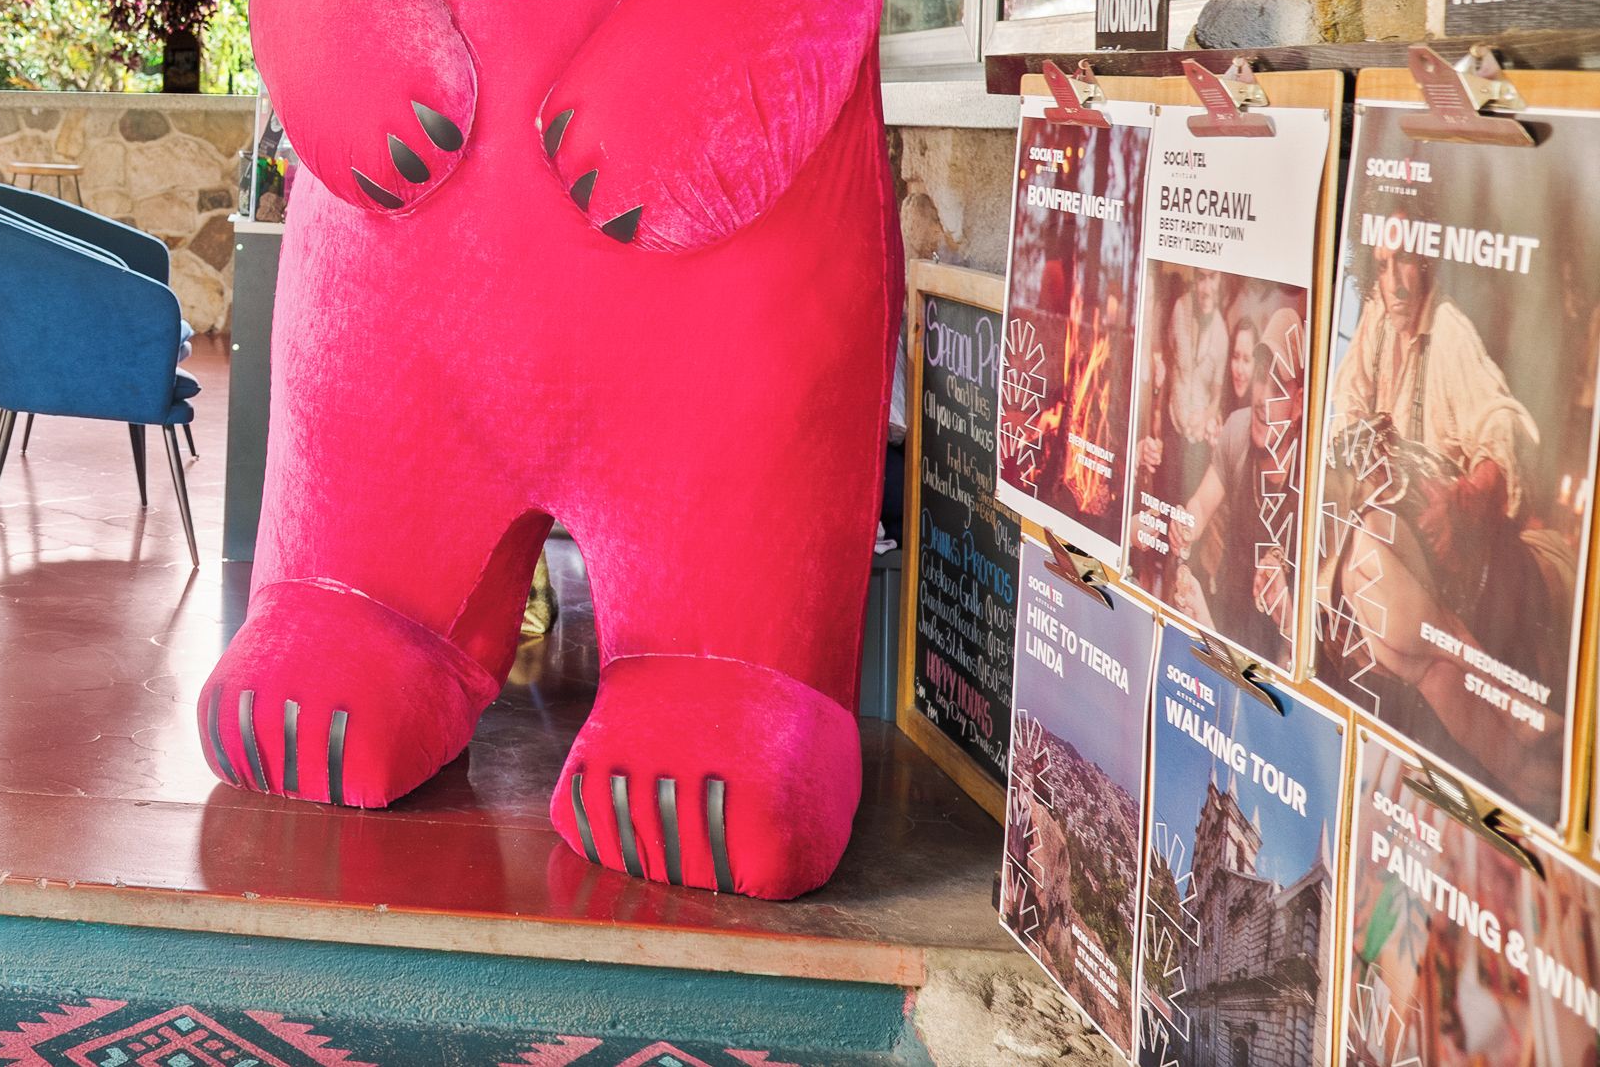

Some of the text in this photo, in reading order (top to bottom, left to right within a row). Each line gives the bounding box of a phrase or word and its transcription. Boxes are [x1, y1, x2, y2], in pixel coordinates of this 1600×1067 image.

[1027, 185, 1124, 222] BONFIRE NIGHT
[1160, 185, 1257, 222] BAR CRAWL
[1158, 234, 1223, 256] EVERY TUESDAY
[1160, 217, 1245, 241] BEST PARTY IN TOWN
[1360, 213, 1540, 274] MOVIE NIGHT
[1086, 440, 1115, 463] MONDAY
[1140, 491, 1160, 512] TOUR
[1155, 518, 1168, 535] PM
[1025, 631, 1064, 678] LINDA
[1027, 603, 1058, 642] HIKE
[1059, 623, 1077, 655] TO
[1079, 637, 1129, 695] TIERRA
[1420, 621, 1551, 705] EVERY WEDNESDAY
[1464, 672, 1511, 711] START
[1165, 696, 1308, 818] WALKING TOUR
[1371, 831, 1501, 954] PAINTING
[1505, 929, 1529, 975] &
[1077, 945, 1099, 974] START
